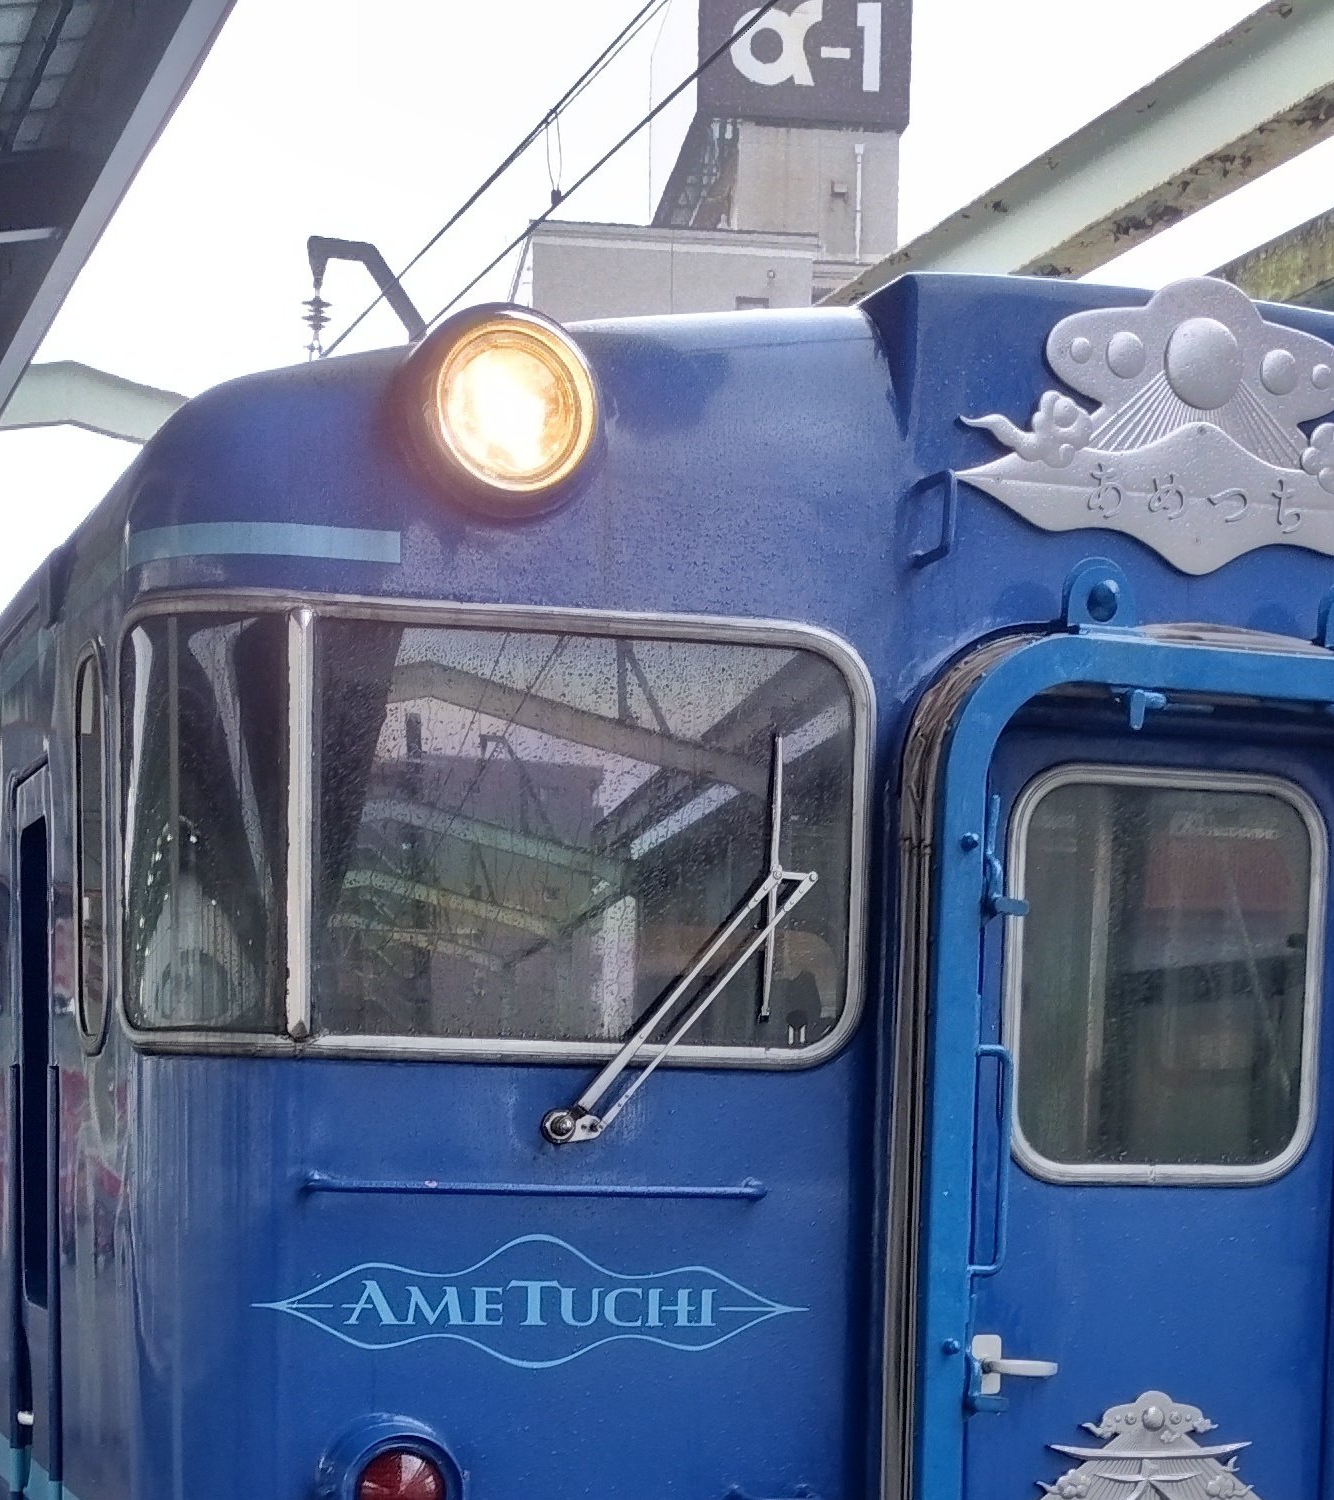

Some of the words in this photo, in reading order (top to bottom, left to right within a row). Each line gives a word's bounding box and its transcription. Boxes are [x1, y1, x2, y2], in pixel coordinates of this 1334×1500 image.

[1087, 463, 1302, 534] あめつち
[343, 1280, 717, 1328] AMETUCHI
